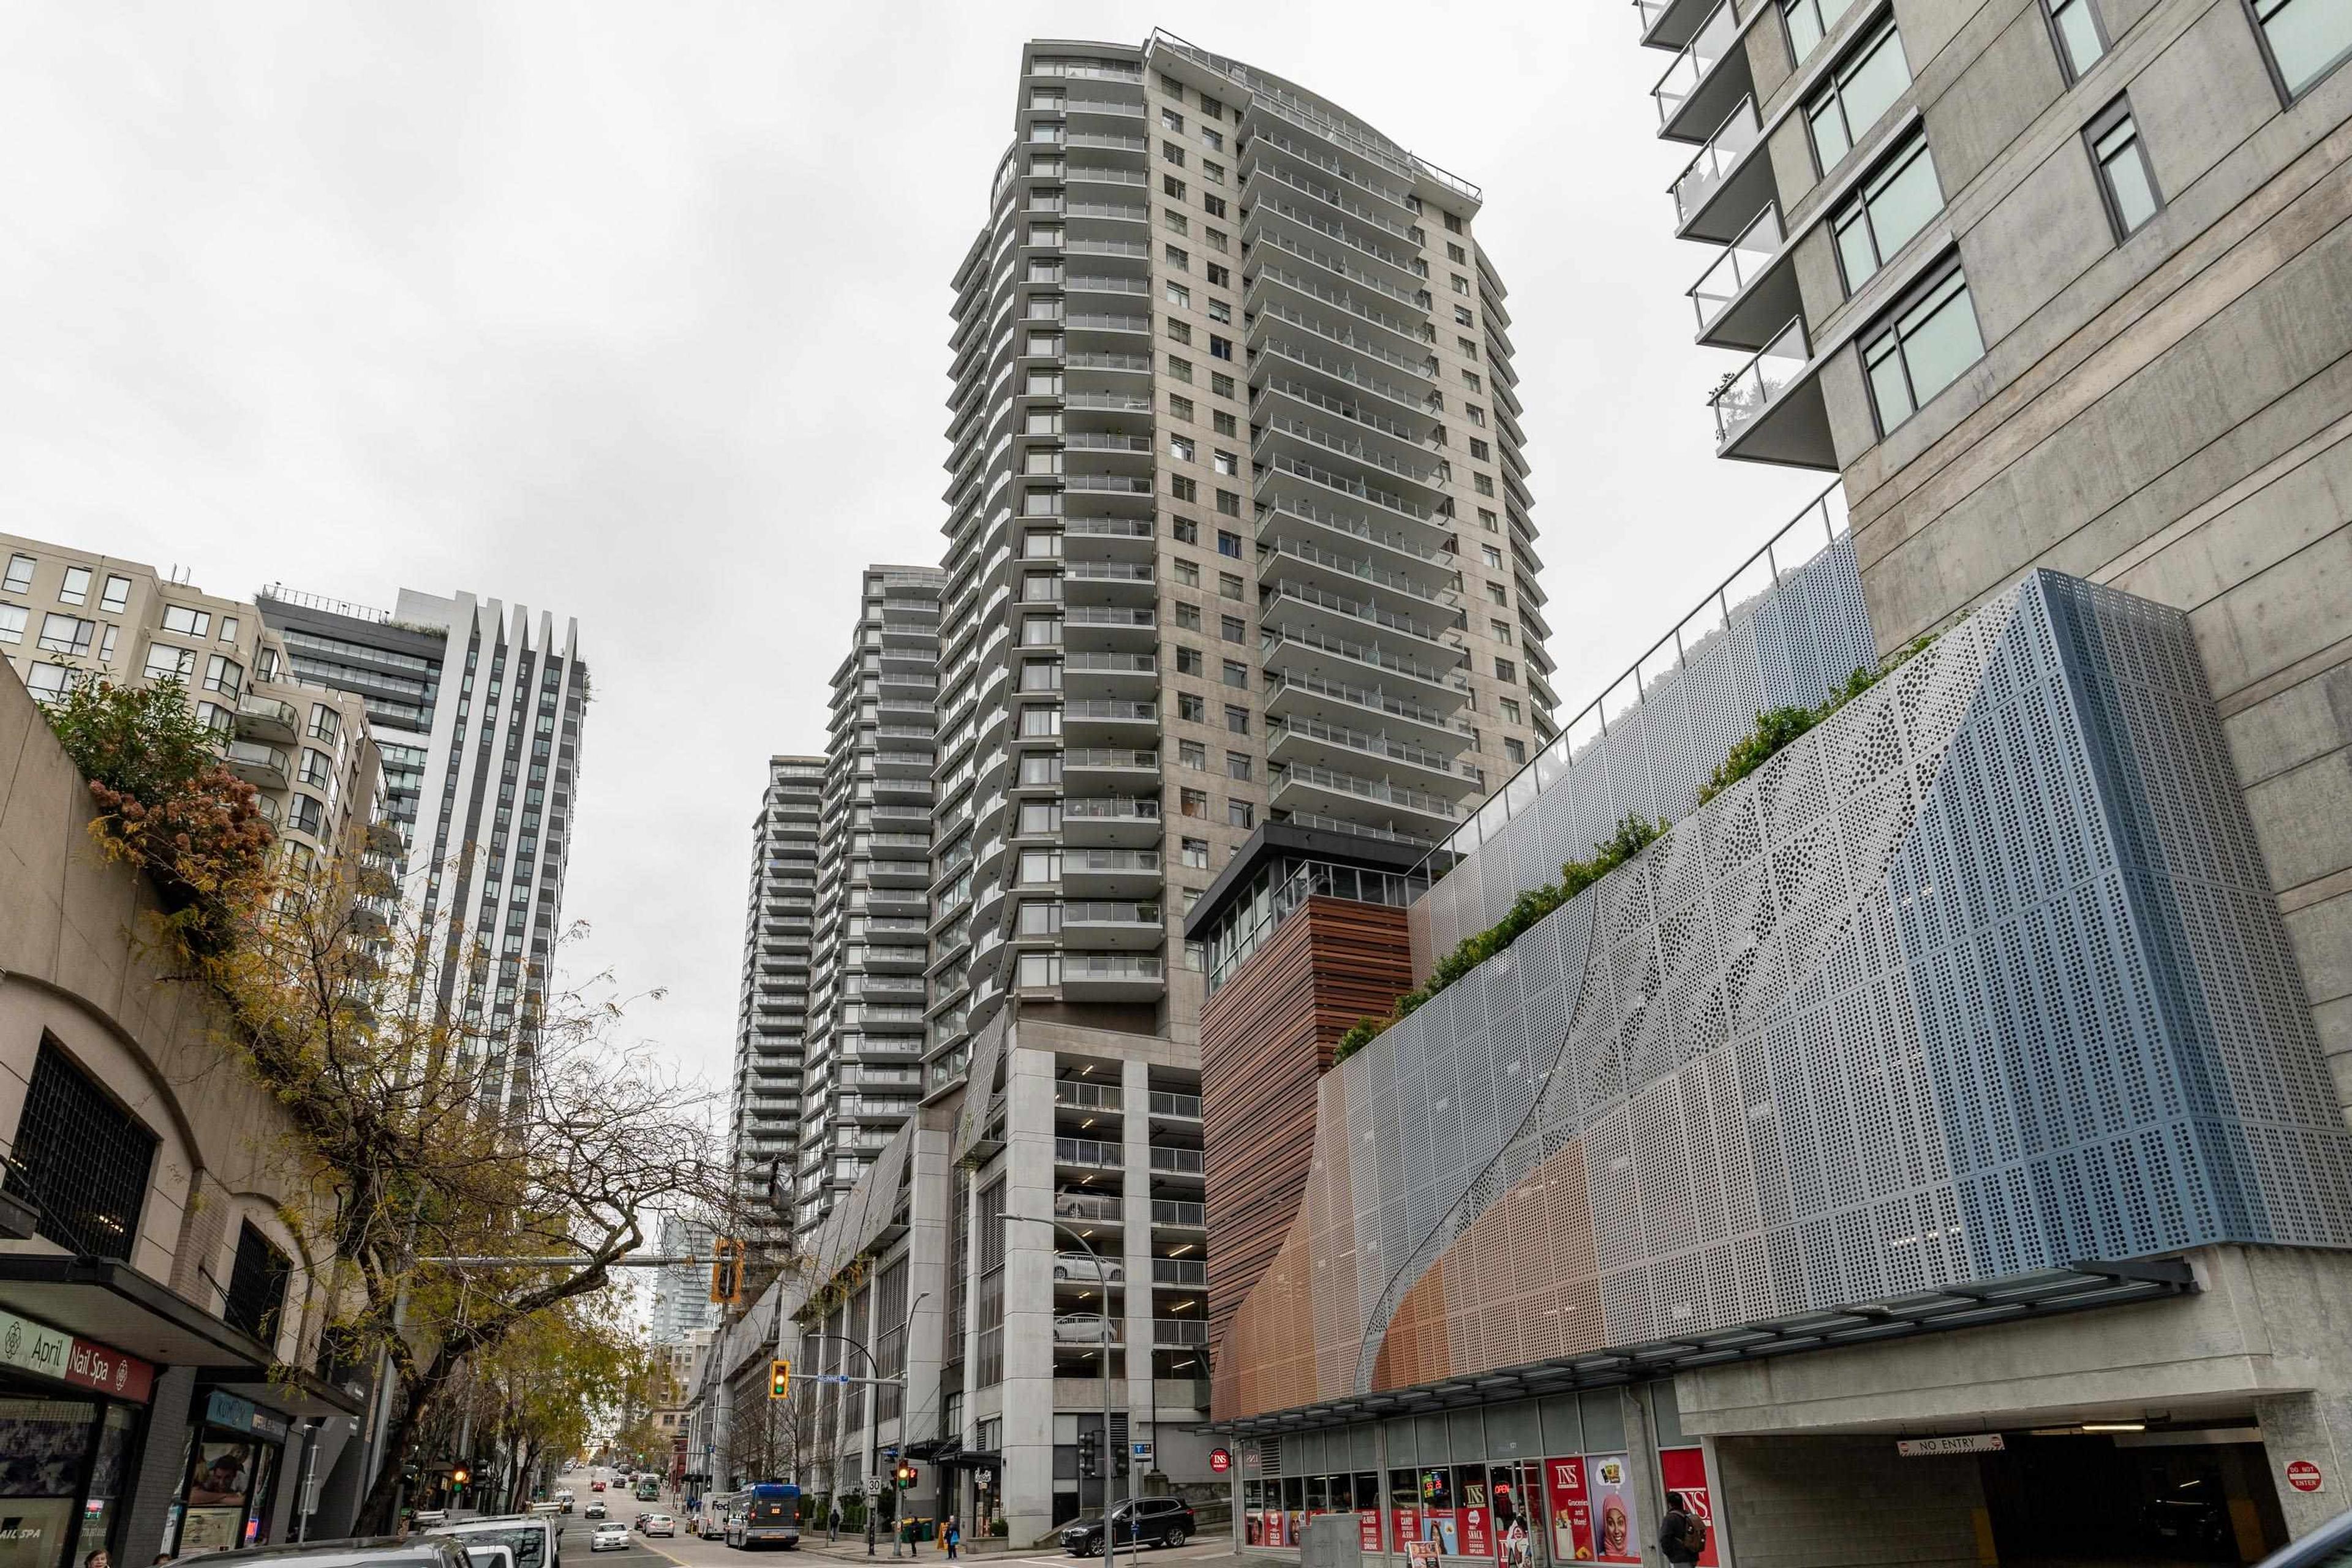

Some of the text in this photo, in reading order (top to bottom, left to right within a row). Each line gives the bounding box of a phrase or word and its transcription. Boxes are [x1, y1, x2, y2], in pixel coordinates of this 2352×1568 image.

[31, 1333, 109, 1385] April Nail Spa
[1920, 1438, 1974, 1450] NO ENTRY
[1556, 1468, 1578, 1484] INS
[869, 1480, 880, 1490] 30
[1494, 1485, 1510, 1494] OPEN
[1466, 1487, 1485, 1503] INS
[18, 1529, 42, 1539] SPA
